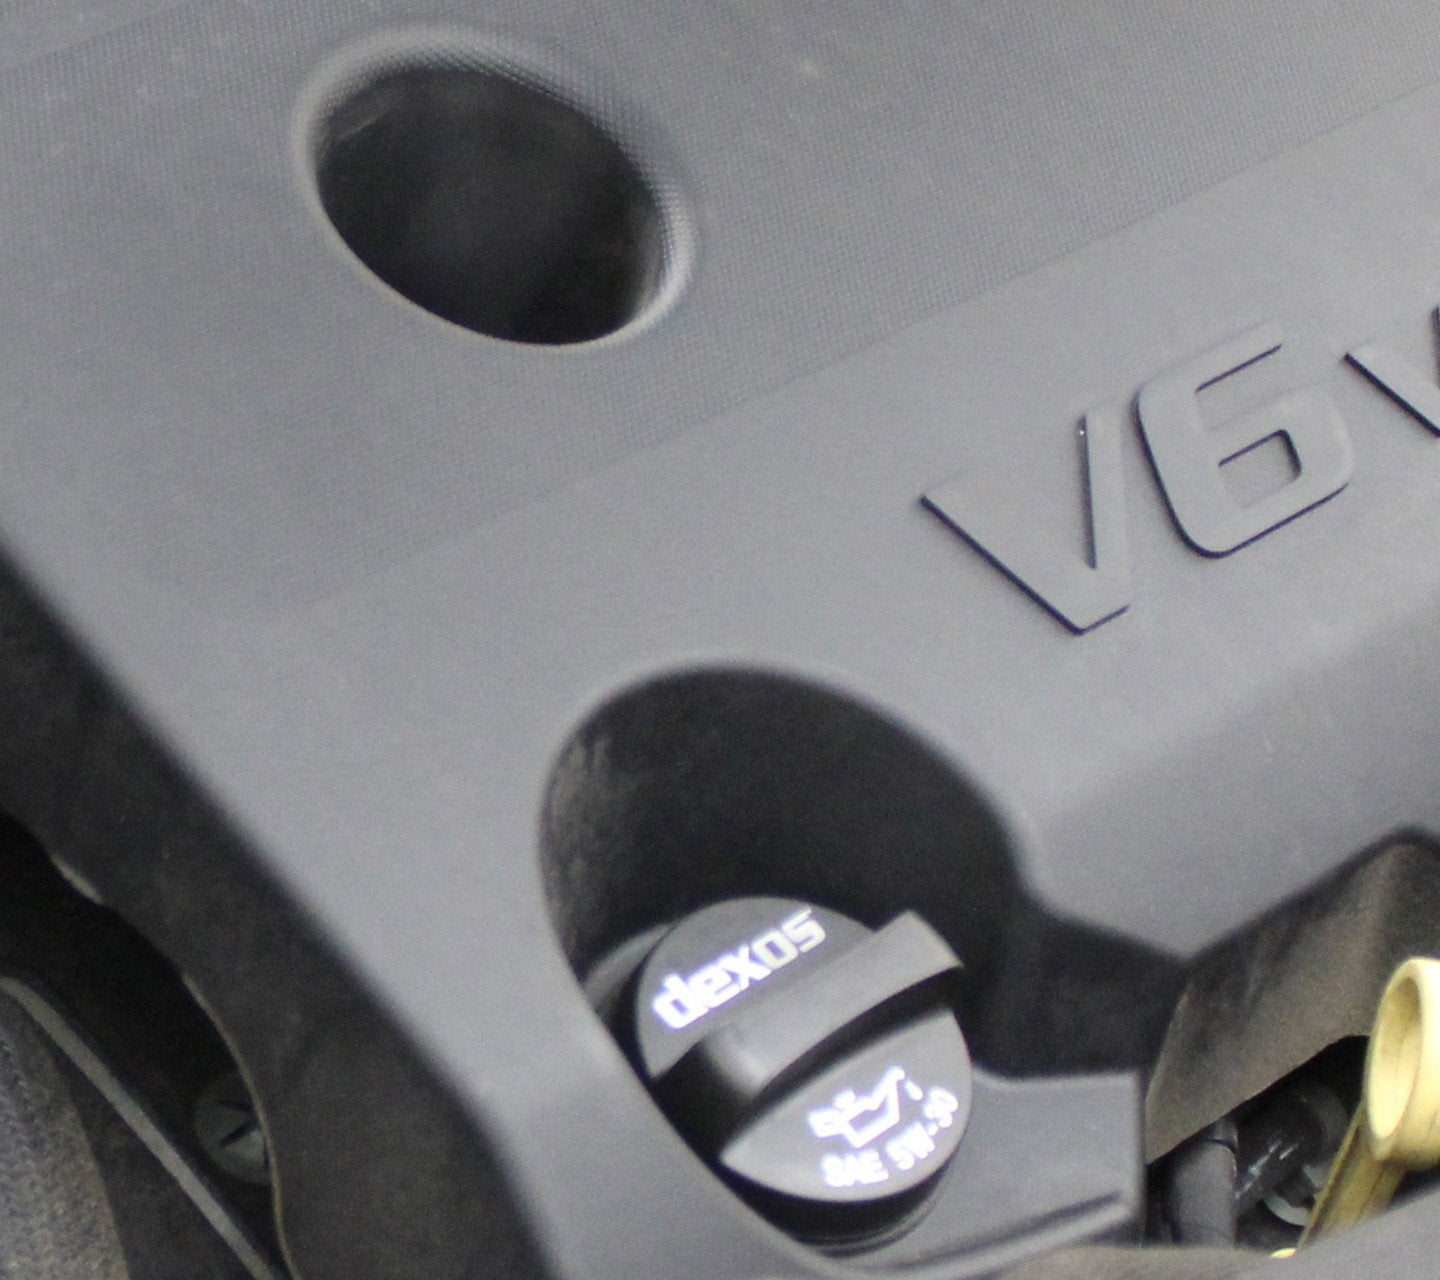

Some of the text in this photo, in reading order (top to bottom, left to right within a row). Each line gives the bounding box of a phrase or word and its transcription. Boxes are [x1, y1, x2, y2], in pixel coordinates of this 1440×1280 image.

[652, 904, 826, 1030] dexos
[821, 1086, 960, 1188] SAE 5W-30
